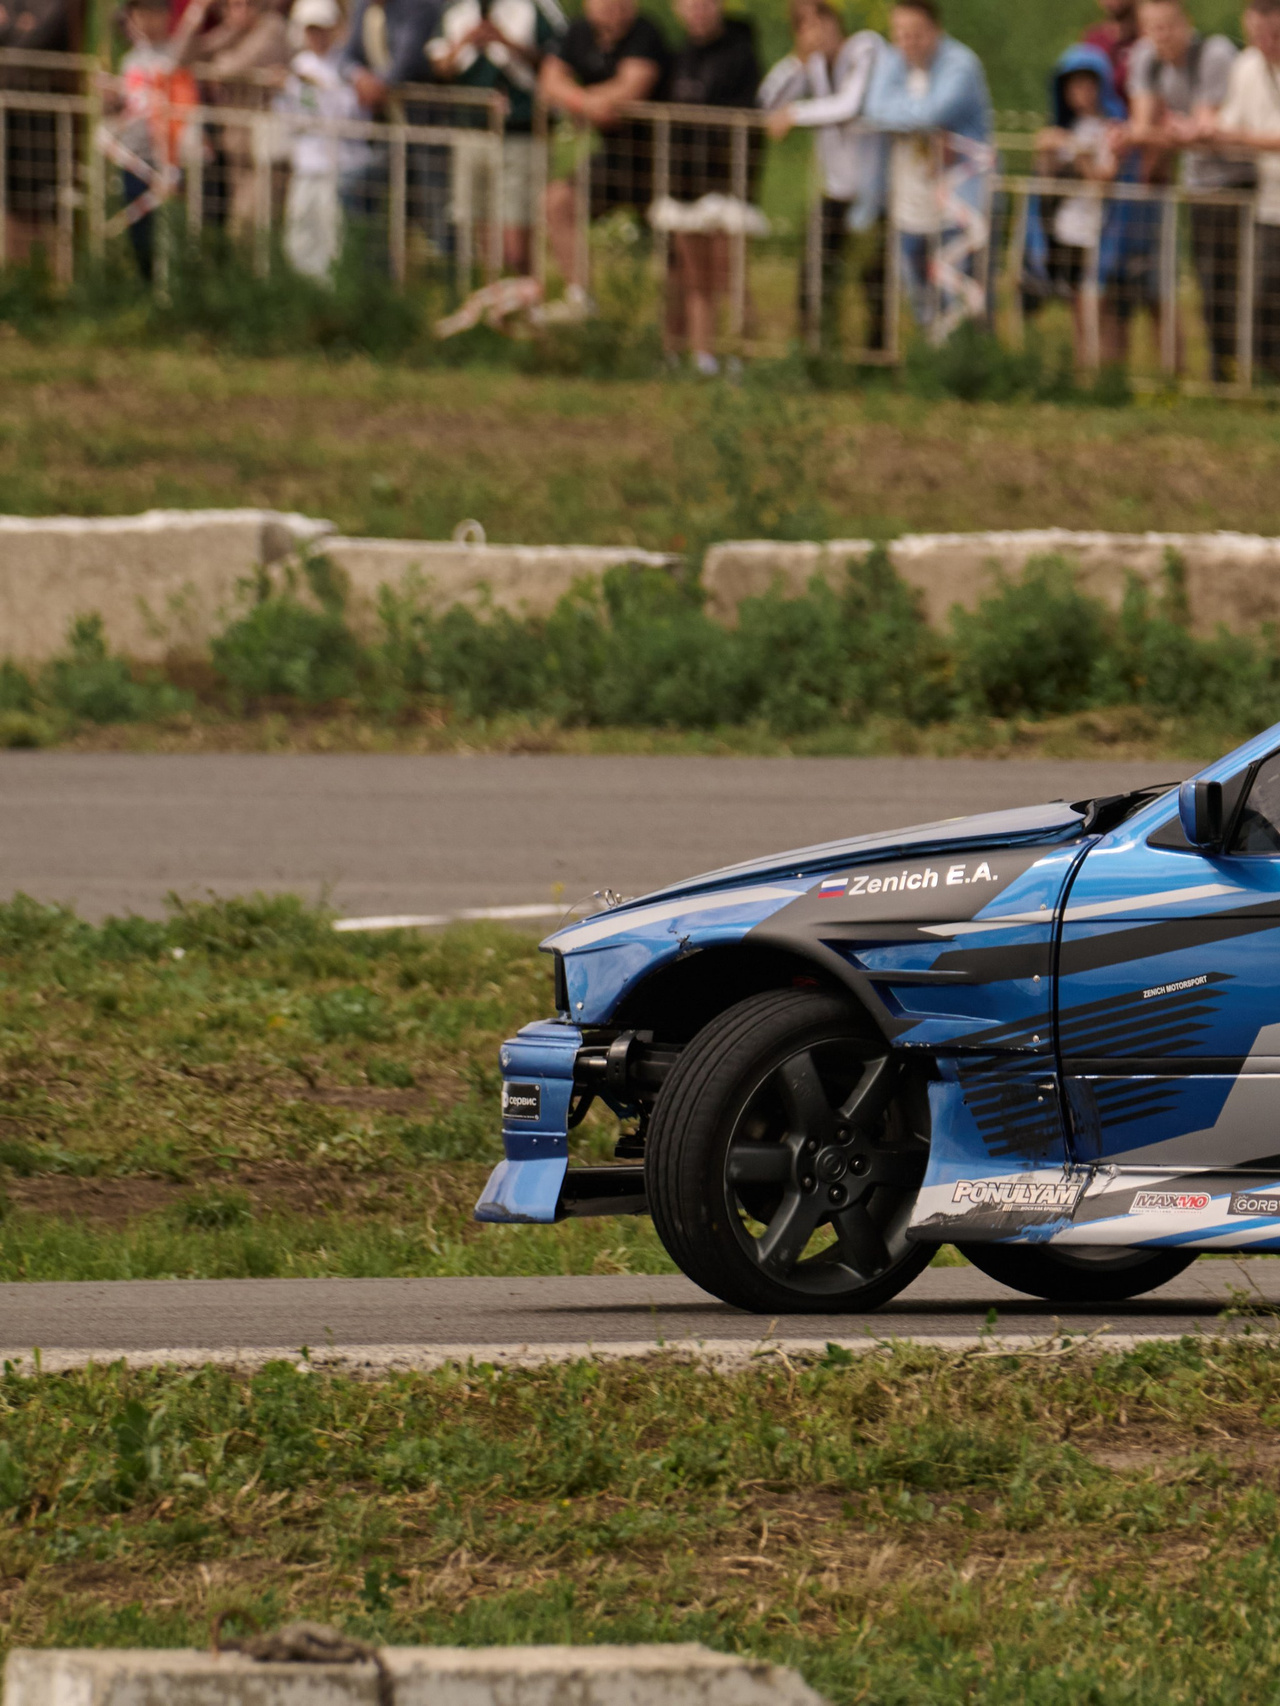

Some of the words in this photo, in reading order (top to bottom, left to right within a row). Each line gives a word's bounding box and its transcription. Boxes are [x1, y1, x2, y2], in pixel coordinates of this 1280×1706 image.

[849, 867, 938, 896] Zenich
[946, 862, 998, 886] E.A.
[1143, 986, 1166, 998] ZENICH
[1165, 975, 1208, 993] MOTORSPORT
[951, 1181, 1081, 1205] PONULYAM
